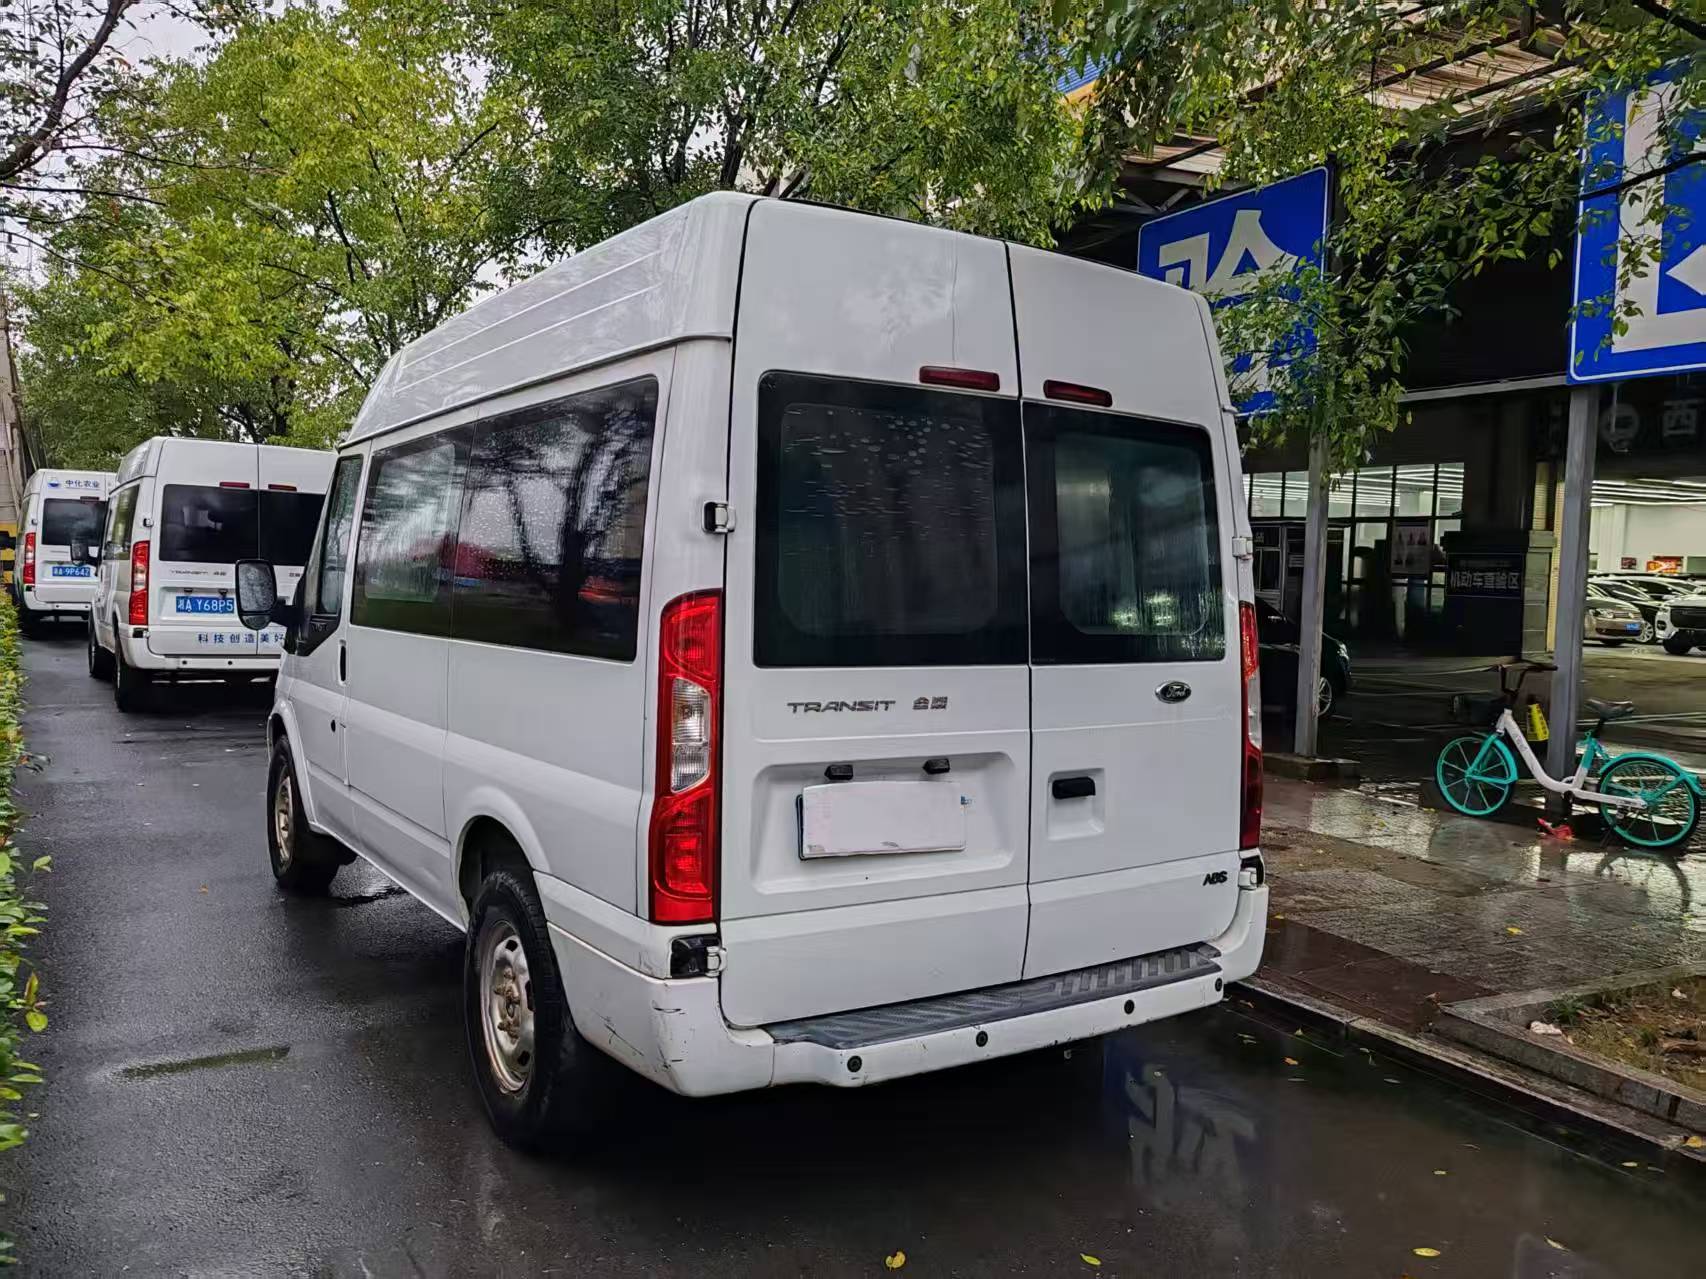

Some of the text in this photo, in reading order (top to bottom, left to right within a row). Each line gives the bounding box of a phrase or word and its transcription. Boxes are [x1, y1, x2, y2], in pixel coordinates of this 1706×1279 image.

[65, 479, 100, 488] 中化农业
[198, 633, 284, 644] 科技创造美好
[787, 699, 897, 714] TRANSIT
[1203, 870, 1228, 887] ABS
